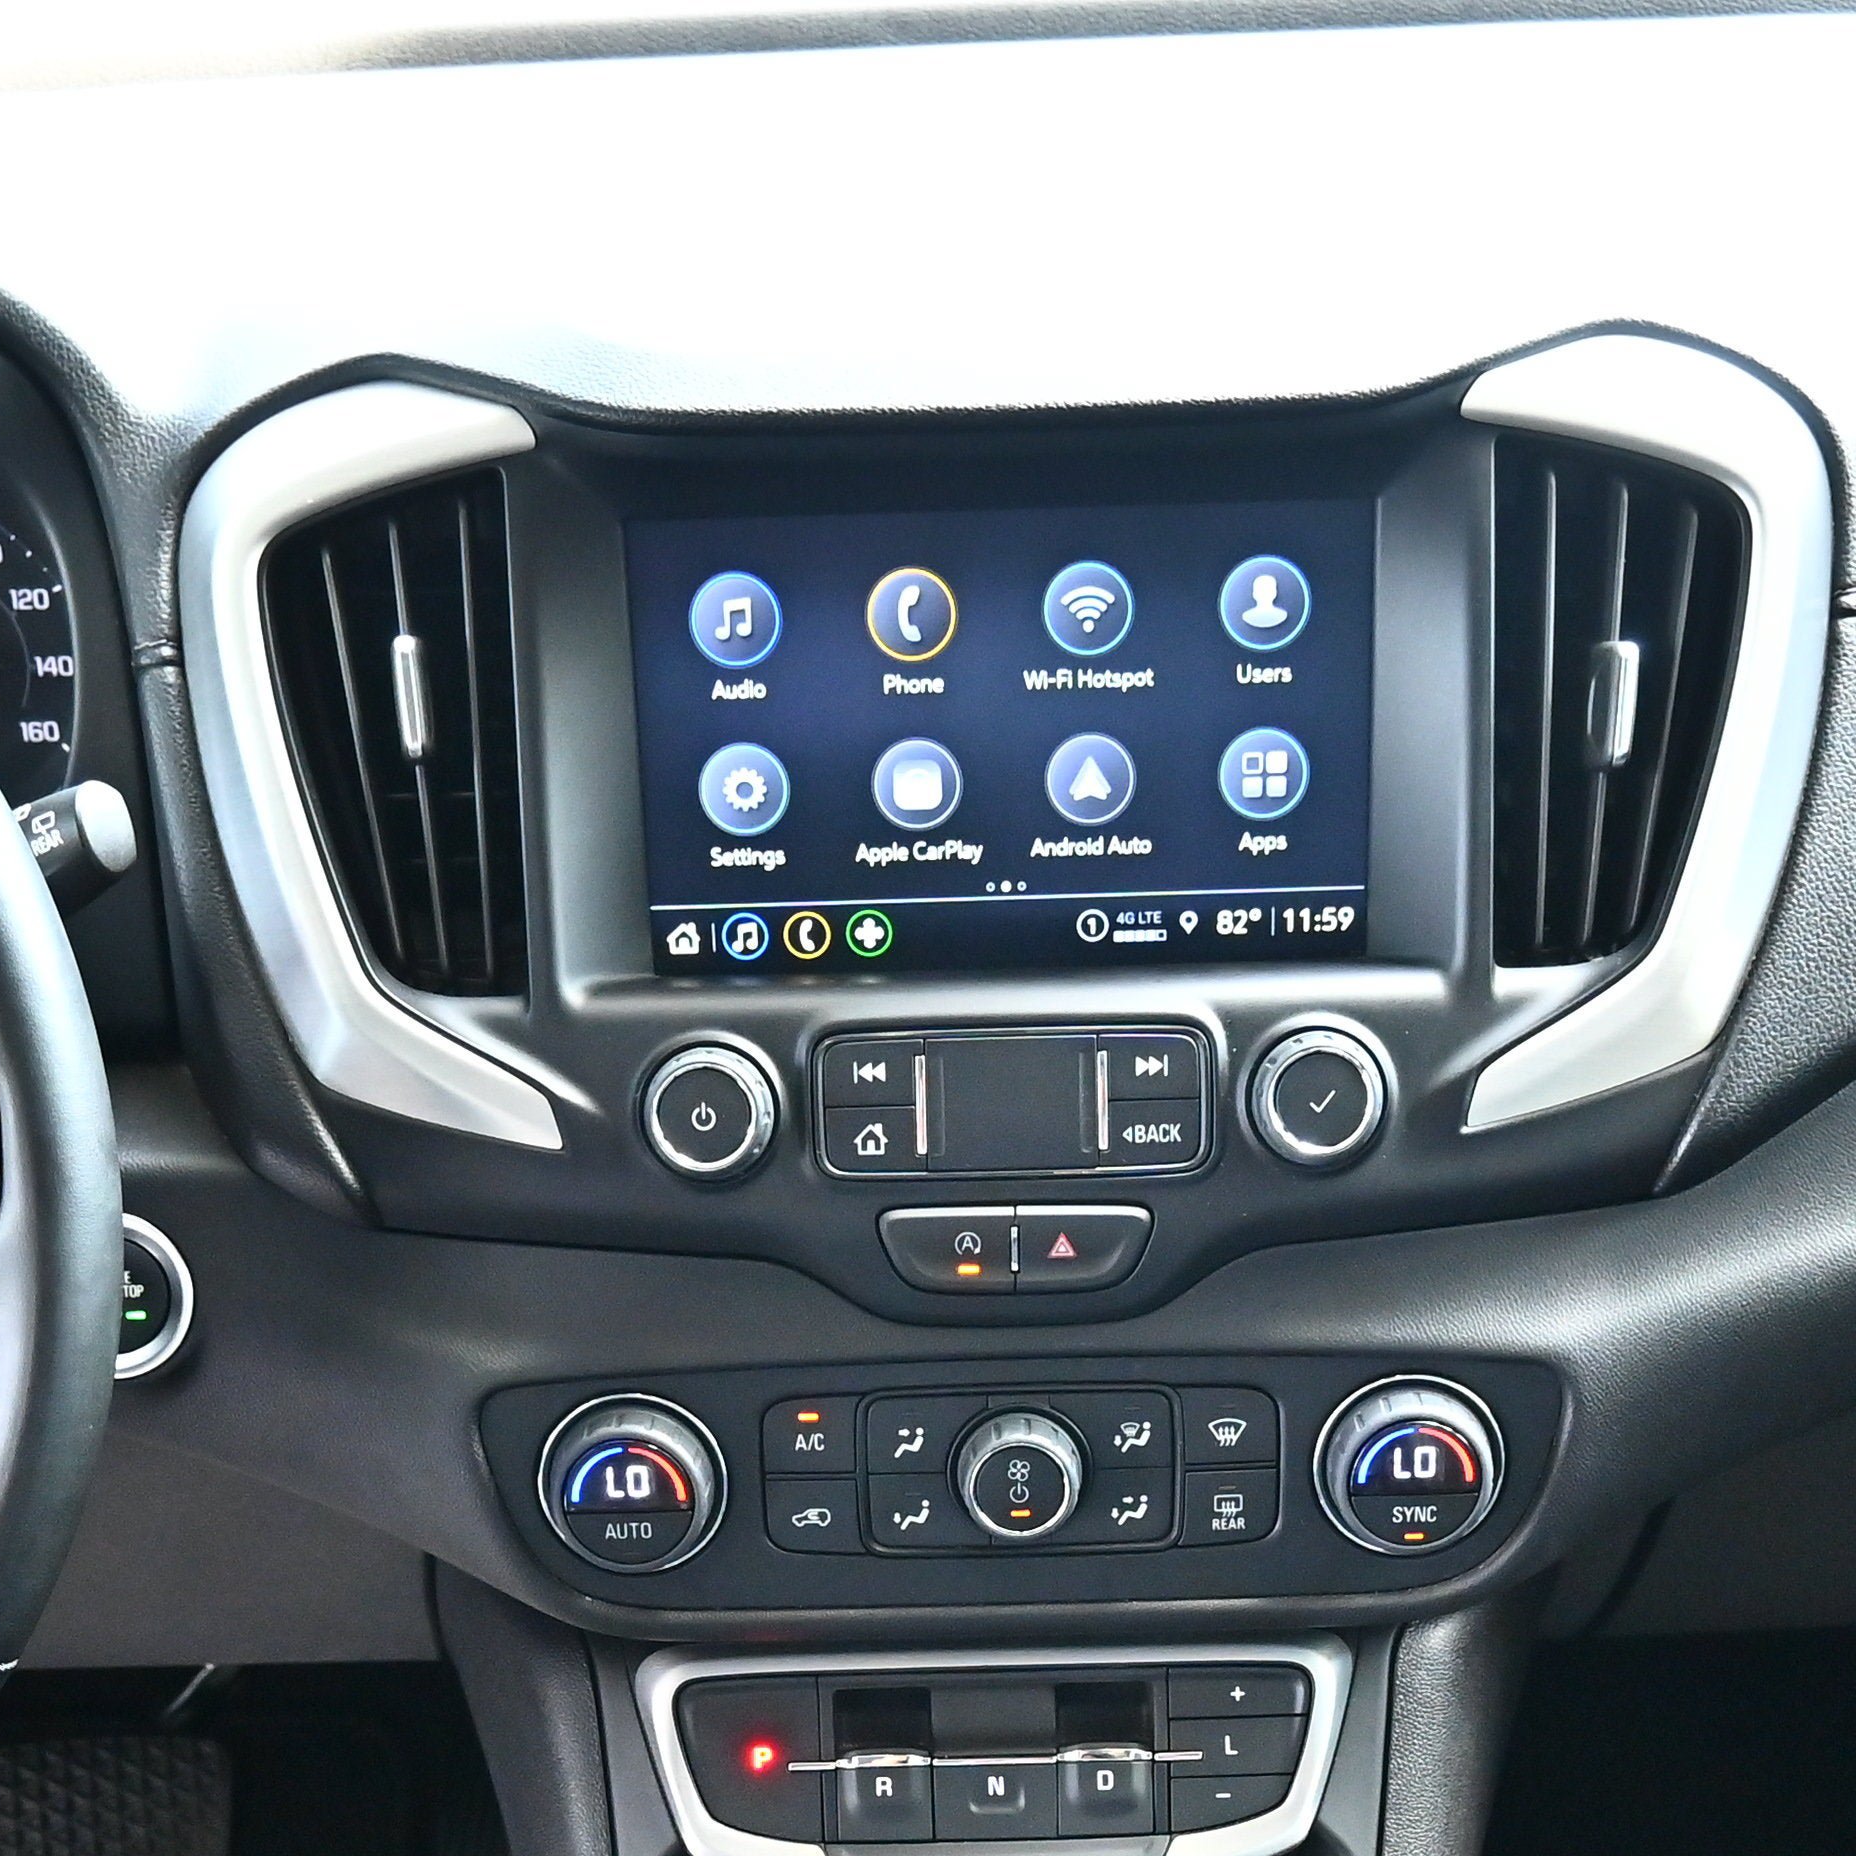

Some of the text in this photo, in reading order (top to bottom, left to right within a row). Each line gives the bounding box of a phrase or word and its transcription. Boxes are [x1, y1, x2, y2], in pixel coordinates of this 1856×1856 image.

[9, 588, 49, 611] 120
[34, 656, 73, 677] 140
[1236, 663, 1292, 685] Users
[712, 677, 767, 702] Audio
[883, 672, 944, 696] Phone
[1024, 665, 1154, 692] Wi-Fi Hotspot
[20, 722, 60, 743] 160
[32, 828, 63, 856] REAR
[855, 839, 983, 866] Apple CarPlay
[1030, 834, 1152, 858] Android Auto
[1238, 830, 1287, 855] Apps
[710, 845, 785, 870] Settings
[1116, 910, 1162, 924] 4G LTE
[1282, 906, 1354, 934] 11:59
[1134, 1123, 1182, 1144] BACK
[795, 1432, 825, 1453] A/C
[1211, 1516, 1246, 1531] REAR
[1392, 1504, 1438, 1525] SYNC
[604, 1520, 652, 1540] AUTO
[1224, 1734, 1237, 1756] L
[754, 1747, 773, 1770] P
[875, 1776, 893, 1797] R
[987, 1776, 1005, 1796] N
[1096, 1770, 1114, 1791] D
